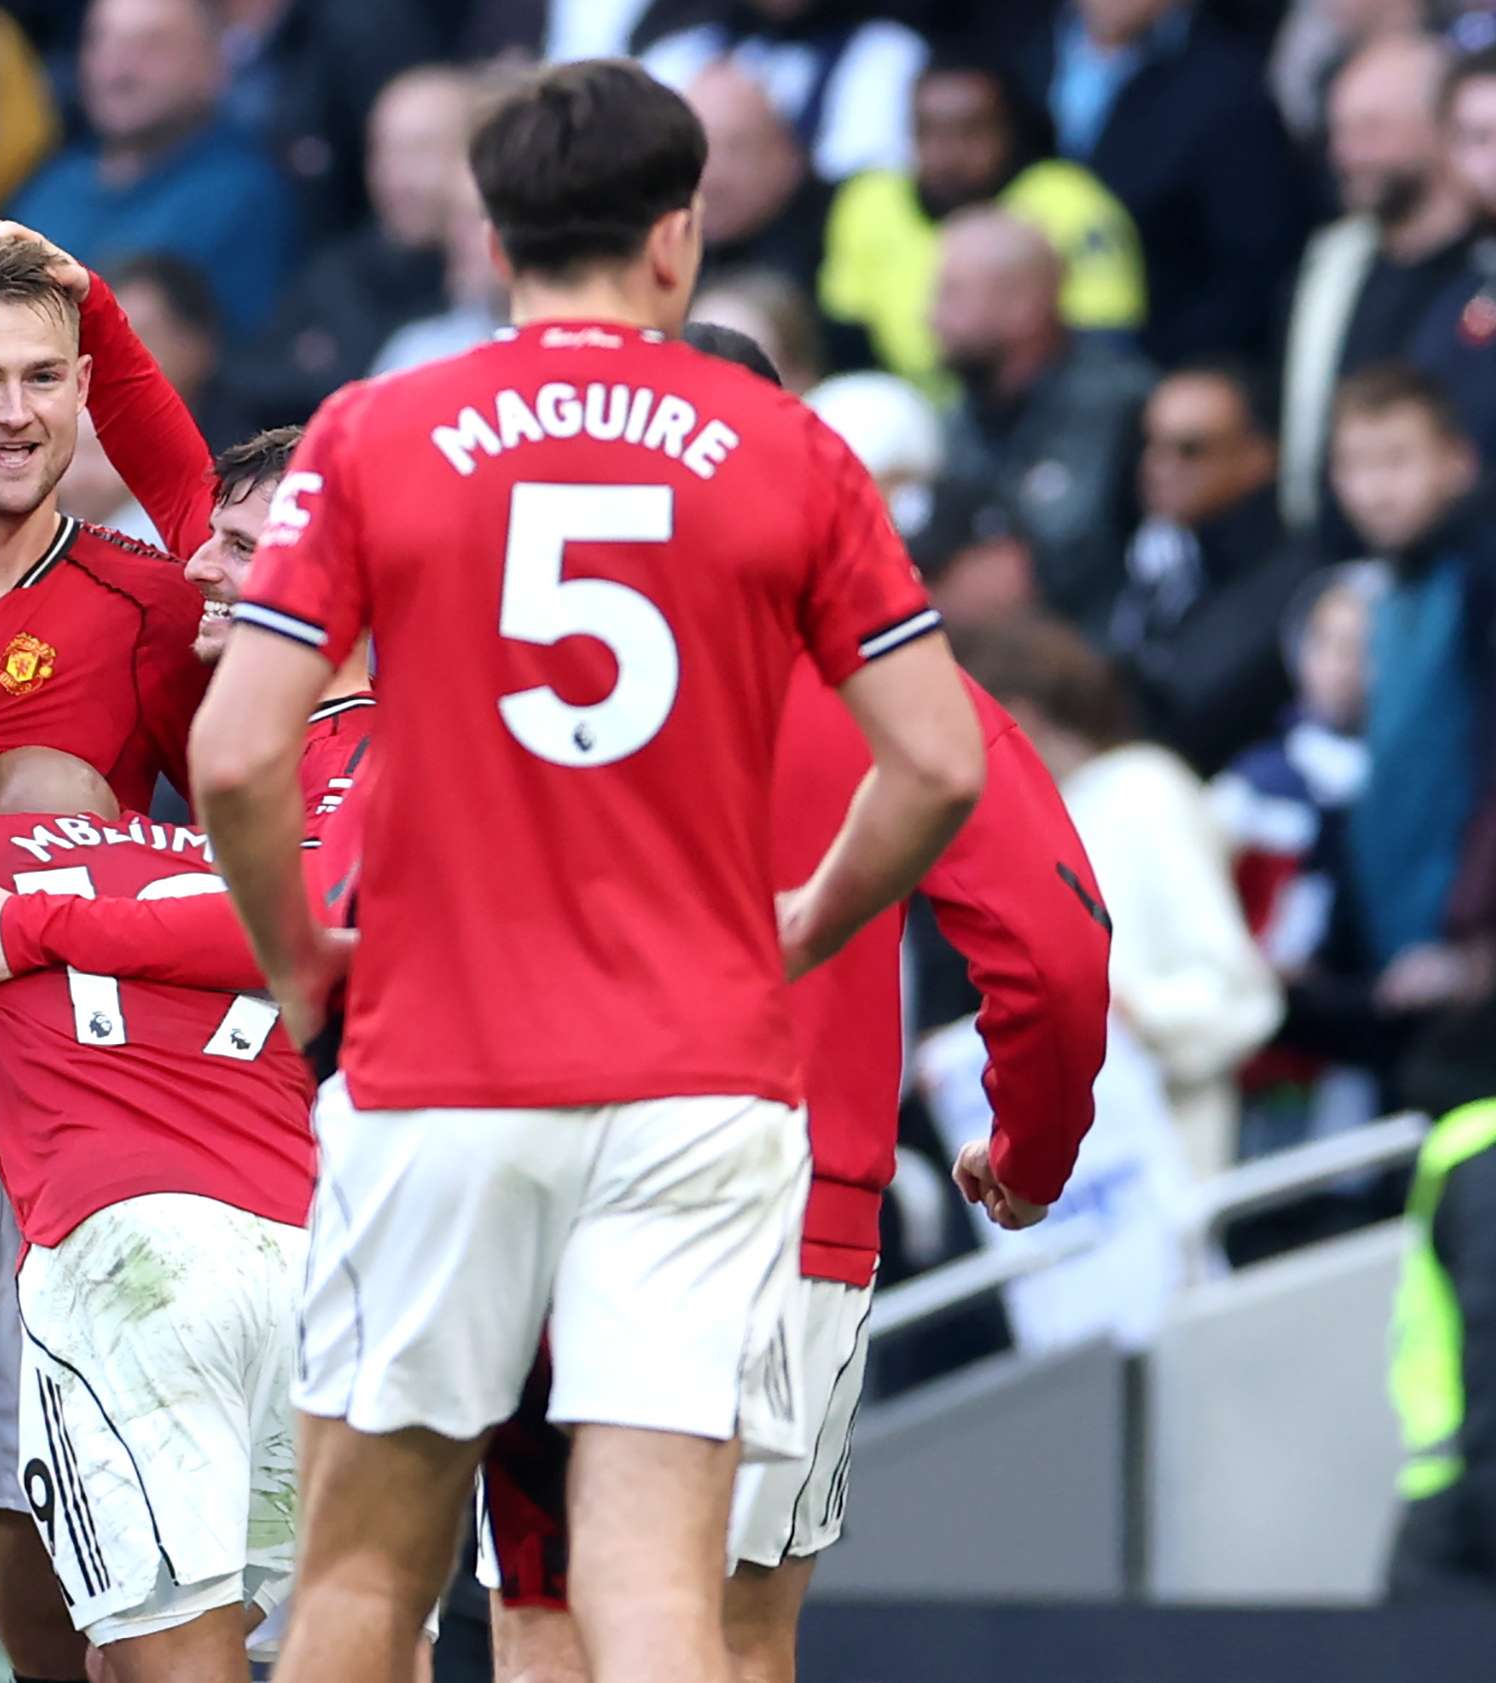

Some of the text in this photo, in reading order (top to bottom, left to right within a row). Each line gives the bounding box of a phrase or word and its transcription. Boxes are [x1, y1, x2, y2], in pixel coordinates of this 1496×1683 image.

[431, 382, 739, 480] MAGUIRE
[498, 482, 680, 768] 5
[23, 1457, 56, 1557] 9
